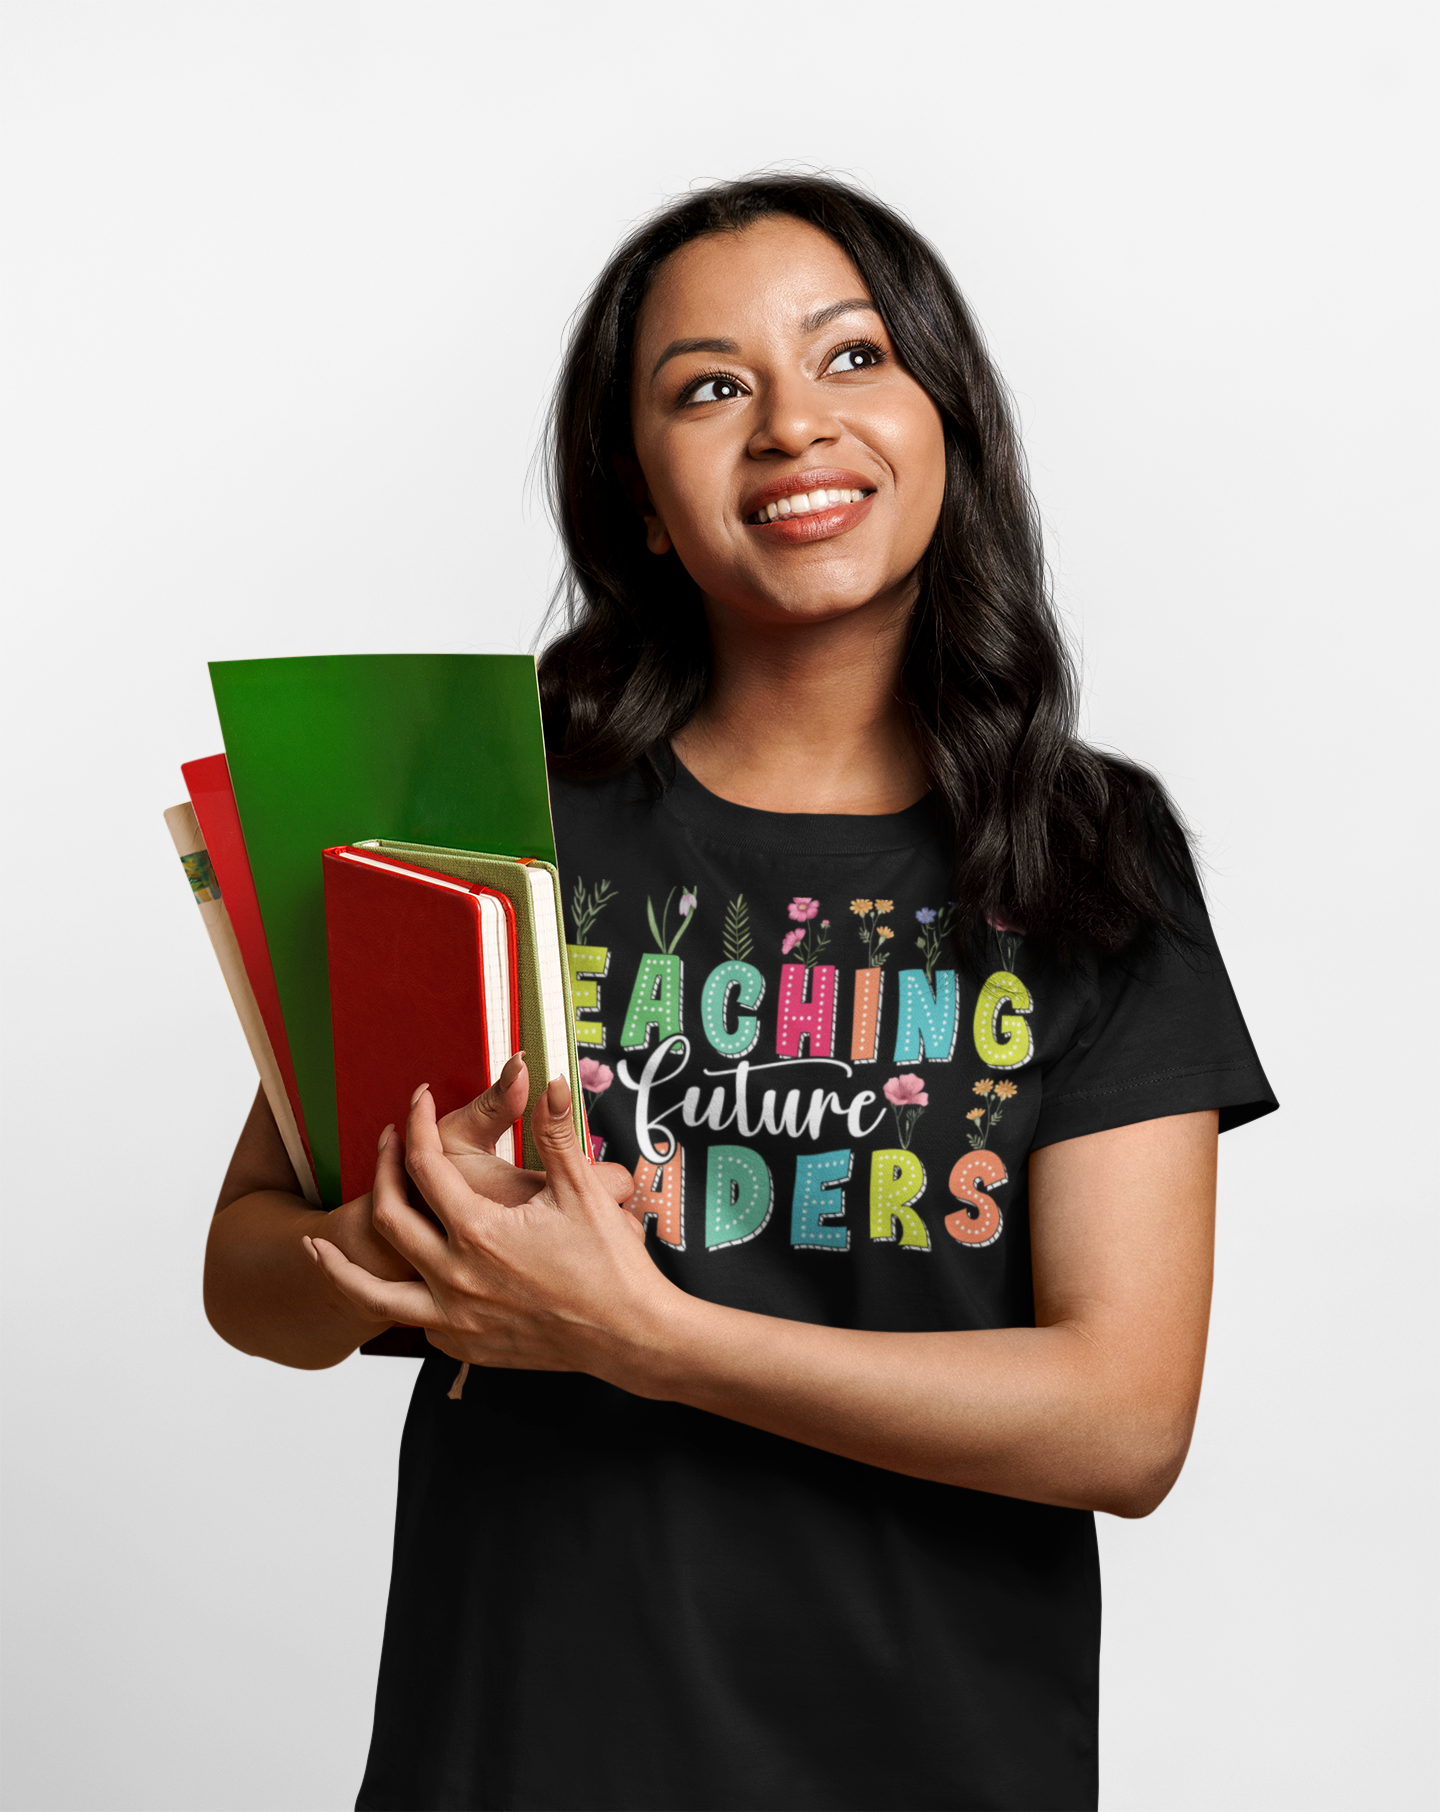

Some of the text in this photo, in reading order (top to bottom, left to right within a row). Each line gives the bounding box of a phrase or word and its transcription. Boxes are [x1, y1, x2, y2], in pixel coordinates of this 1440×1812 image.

[566, 944, 1035, 1070] EACHING
[617, 1034, 887, 1165] future
[590, 1135, 1008, 1252] ADERS
